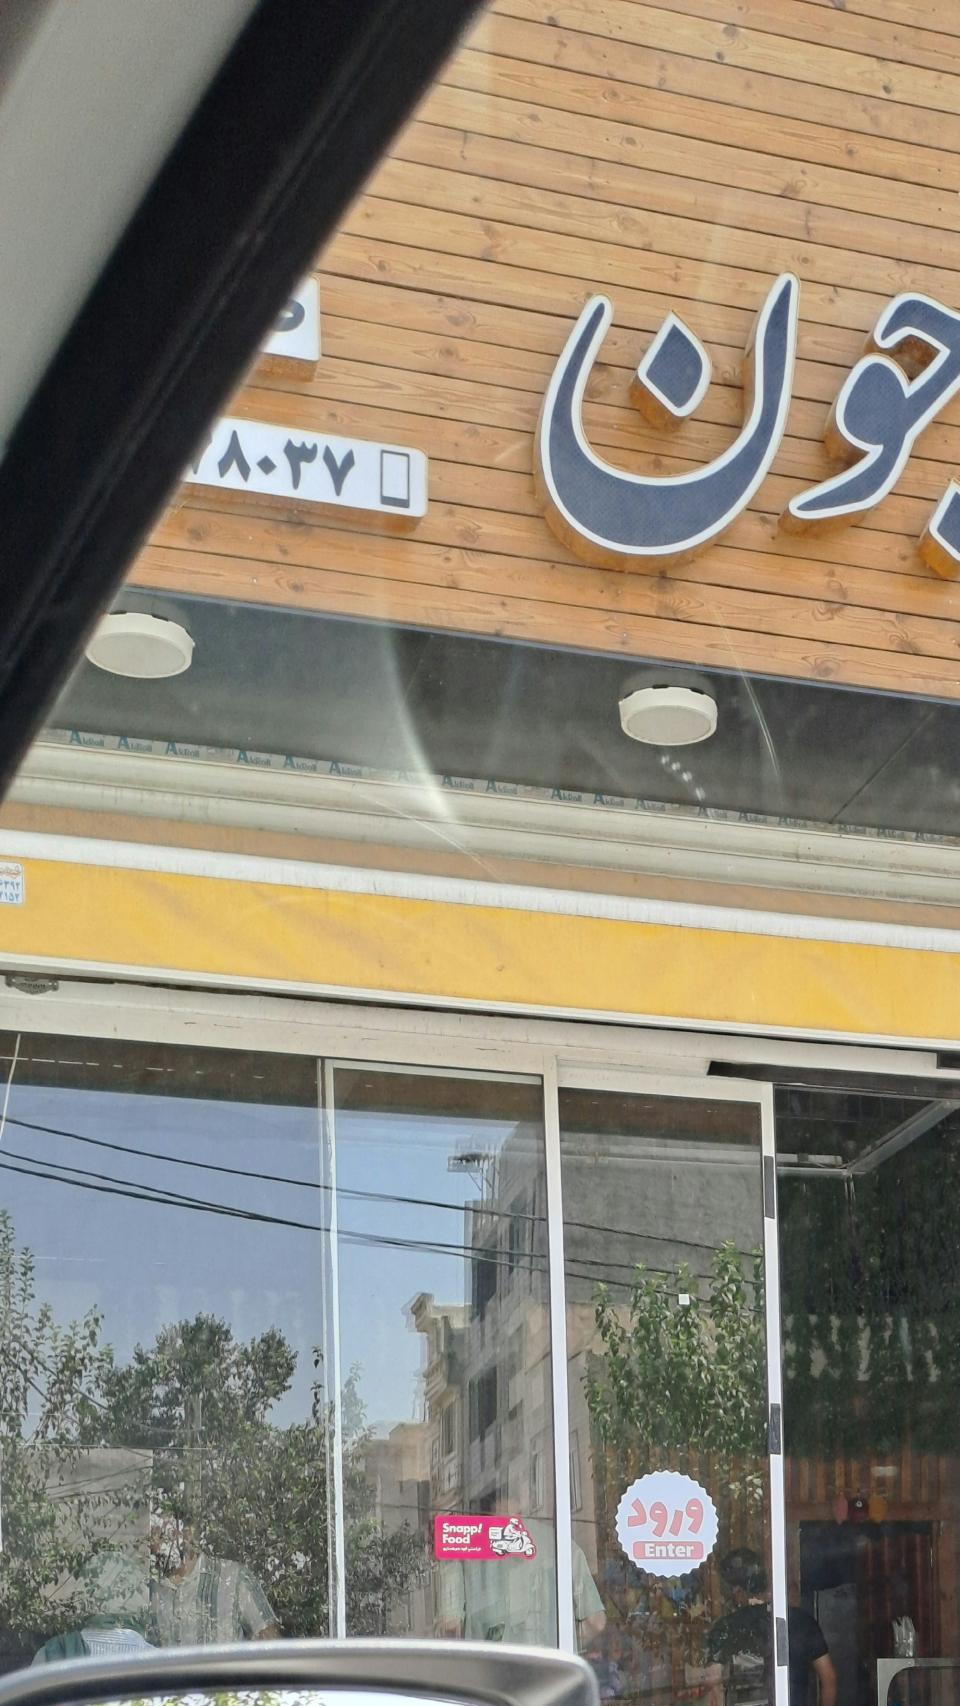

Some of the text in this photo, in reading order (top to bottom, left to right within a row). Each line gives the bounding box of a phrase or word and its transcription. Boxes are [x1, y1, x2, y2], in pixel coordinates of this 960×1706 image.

[191, 429, 355, 497] ۸۰۳۷
[628, 1498, 703, 1537] ورود
[442, 1523, 482, 1535] Snapp!
[442, 1534, 470, 1544] Food
[644, 1542, 694, 1558] Enter
